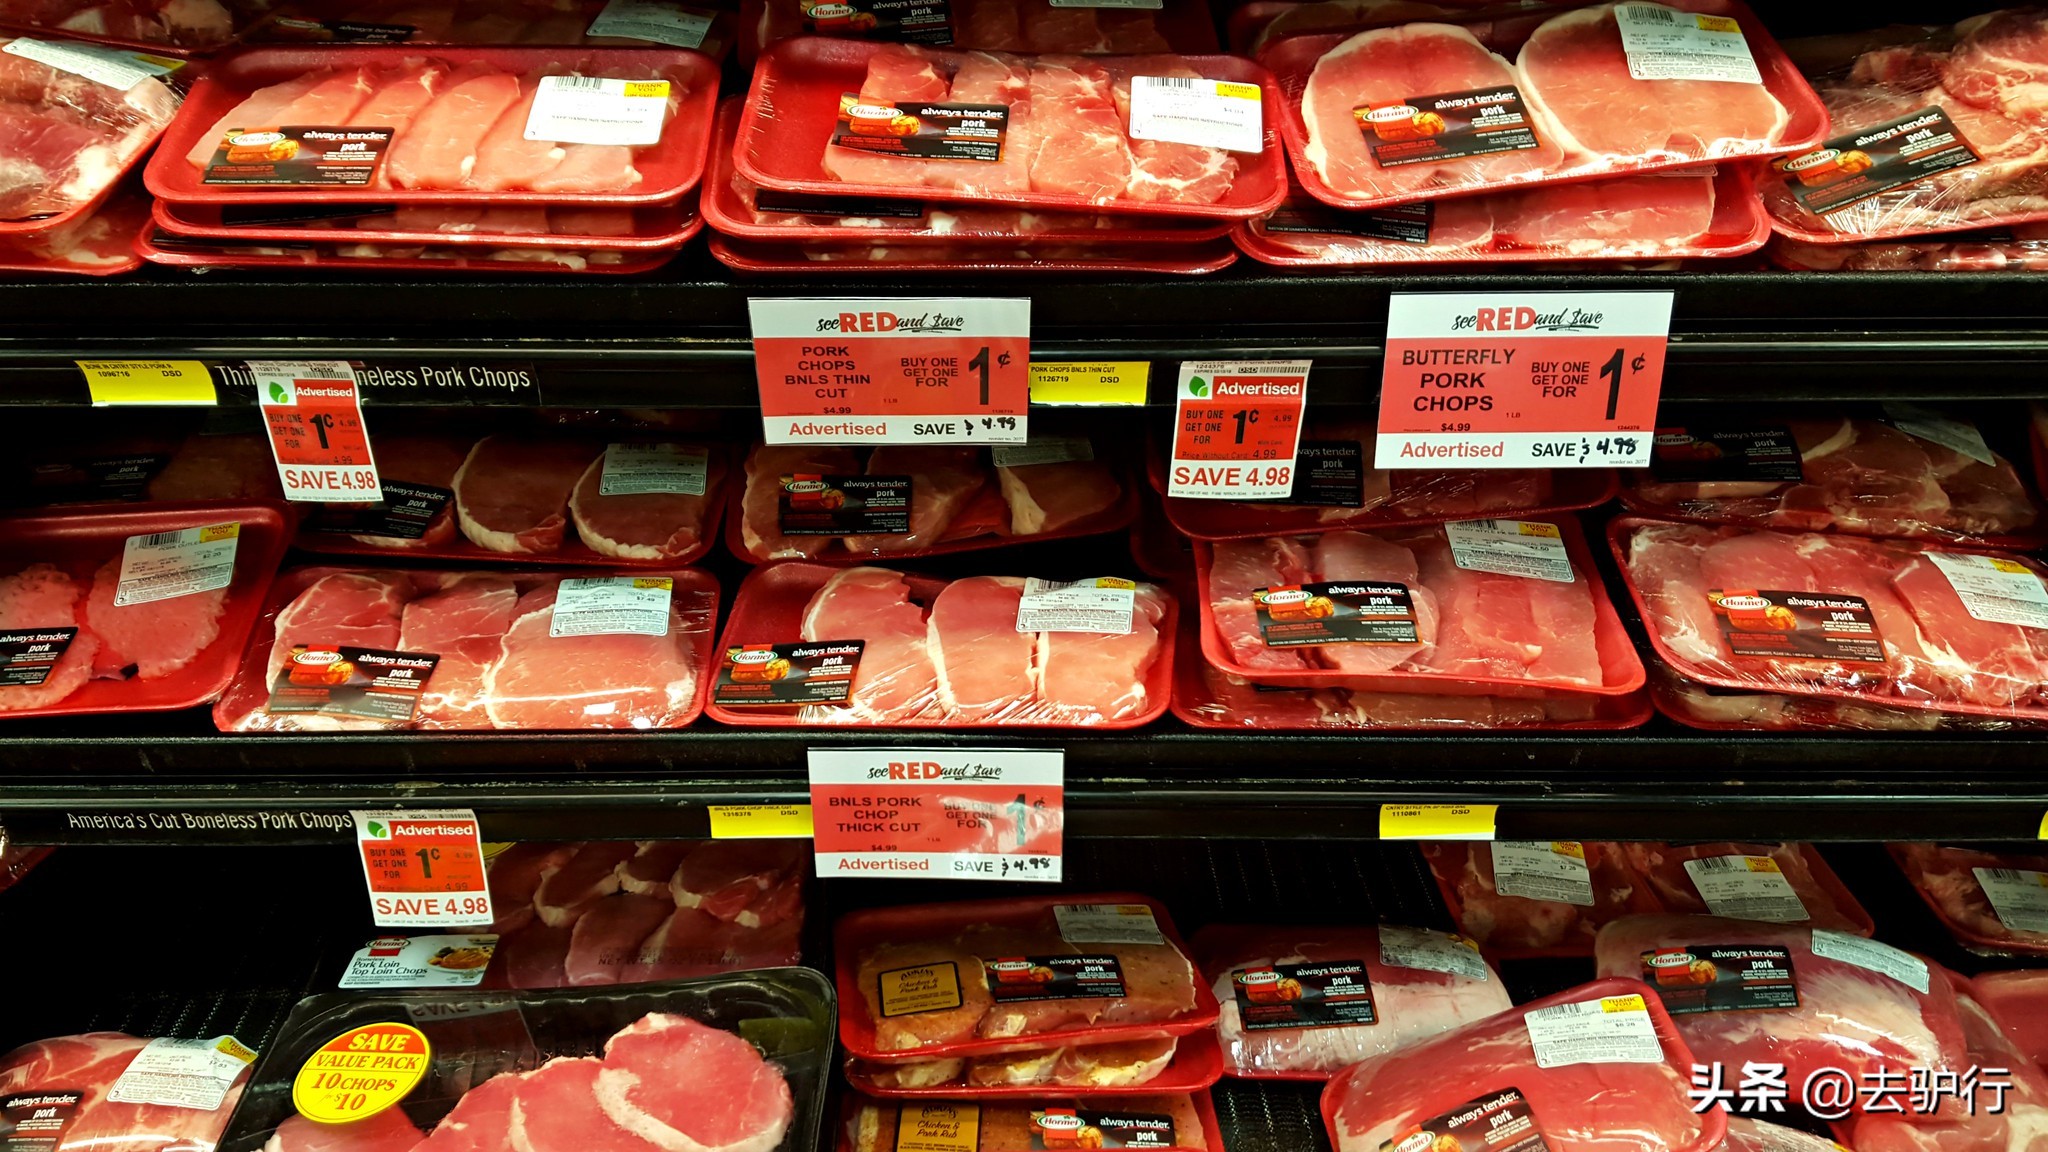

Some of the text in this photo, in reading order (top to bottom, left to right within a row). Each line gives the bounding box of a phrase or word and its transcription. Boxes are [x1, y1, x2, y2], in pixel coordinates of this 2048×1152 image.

[1855, 127, 1898, 146] always
[1907, 128, 1933, 143] pork
[1791, 151, 1832, 168] Hormel
[802, 346, 849, 356] PORK
[901, 358, 958, 366] BUY ONE
[1402, 349, 1516, 365] BUTTERFLY
[798, 361, 855, 370] CHOPS
[1531, 362, 1590, 372] BUY ONE
[903, 368, 958, 377] GET ONE
[420, 366, 465, 386] Pork
[469, 366, 530, 392] Chops
[785, 375, 870, 384] BNLS THIN
[916, 378, 948, 387] FOR
[1420, 372, 1486, 388] PORK
[1532, 374, 1589, 384] GET ONE
[296, 387, 352, 397] Advertised
[815, 388, 847, 398] CUT
[1217, 382, 1299, 395] Advertised
[1542, 386, 1576, 397] FOR
[1413, 396, 1493, 411] CHOPS
[269, 414, 302, 423] BUY ONE
[1186, 410, 1224, 418] BUY ONE
[274, 427, 305, 436] GET ONE
[789, 423, 886, 435] Advertised
[913, 424, 955, 435] SAVE
[1186, 423, 1222, 431] GET ONE
[1441, 423, 1470, 432] $4.99
[285, 440, 300, 448] FOR
[1194, 436, 1210, 444] FOR
[1253, 449, 1276, 458] 4.99
[1400, 442, 1504, 458] Advertised
[1532, 443, 1576, 456] SAVE
[285, 470, 376, 489] SAVE 4.98
[1174, 467, 1290, 486] SAVE 4.98
[1329, 586, 1366, 594] always
[1370, 596, 1393, 605] pork
[1787, 597, 1826, 607] always
[1831, 611, 1855, 621] pork
[792, 648, 825, 656] always
[358, 654, 396, 665] always
[822, 655, 843, 666] pork
[389, 669, 413, 678] pork
[829, 798, 921, 806] BNLS PORK
[854, 810, 898, 819] CHOP
[67, 812, 351, 831] America's Cut Boneless Pork Chops
[957, 820, 987, 828] FOR
[395, 825, 473, 835] Advertised
[837, 823, 921, 832] THICK CUT
[838, 859, 929, 870] Advertised
[954, 861, 993, 872] SAVE
[376, 898, 488, 915] SAVE 4.98
[1712, 950, 1747, 958] always
[1655, 956, 1689, 964] Hormel
[1752, 960, 1773, 969] pork
[1296, 968, 1328, 976] always
[1332, 976, 1352, 985] pork
[348, 1033, 410, 1051] SAVE
[316, 1055, 419, 1069] VALUE PACK
[312, 1073, 397, 1091] 10 CHOPS
[1045, 1118, 1078, 1126] Hormel
[1448, 1107, 1483, 1128] always
[1490, 1109, 1513, 1128] pork
[917, 1121, 950, 1129] Chicken
[1100, 1118, 1134, 1128] always
[940, 1130, 957, 1138] Rub
[1137, 1131, 1157, 1141] pork
